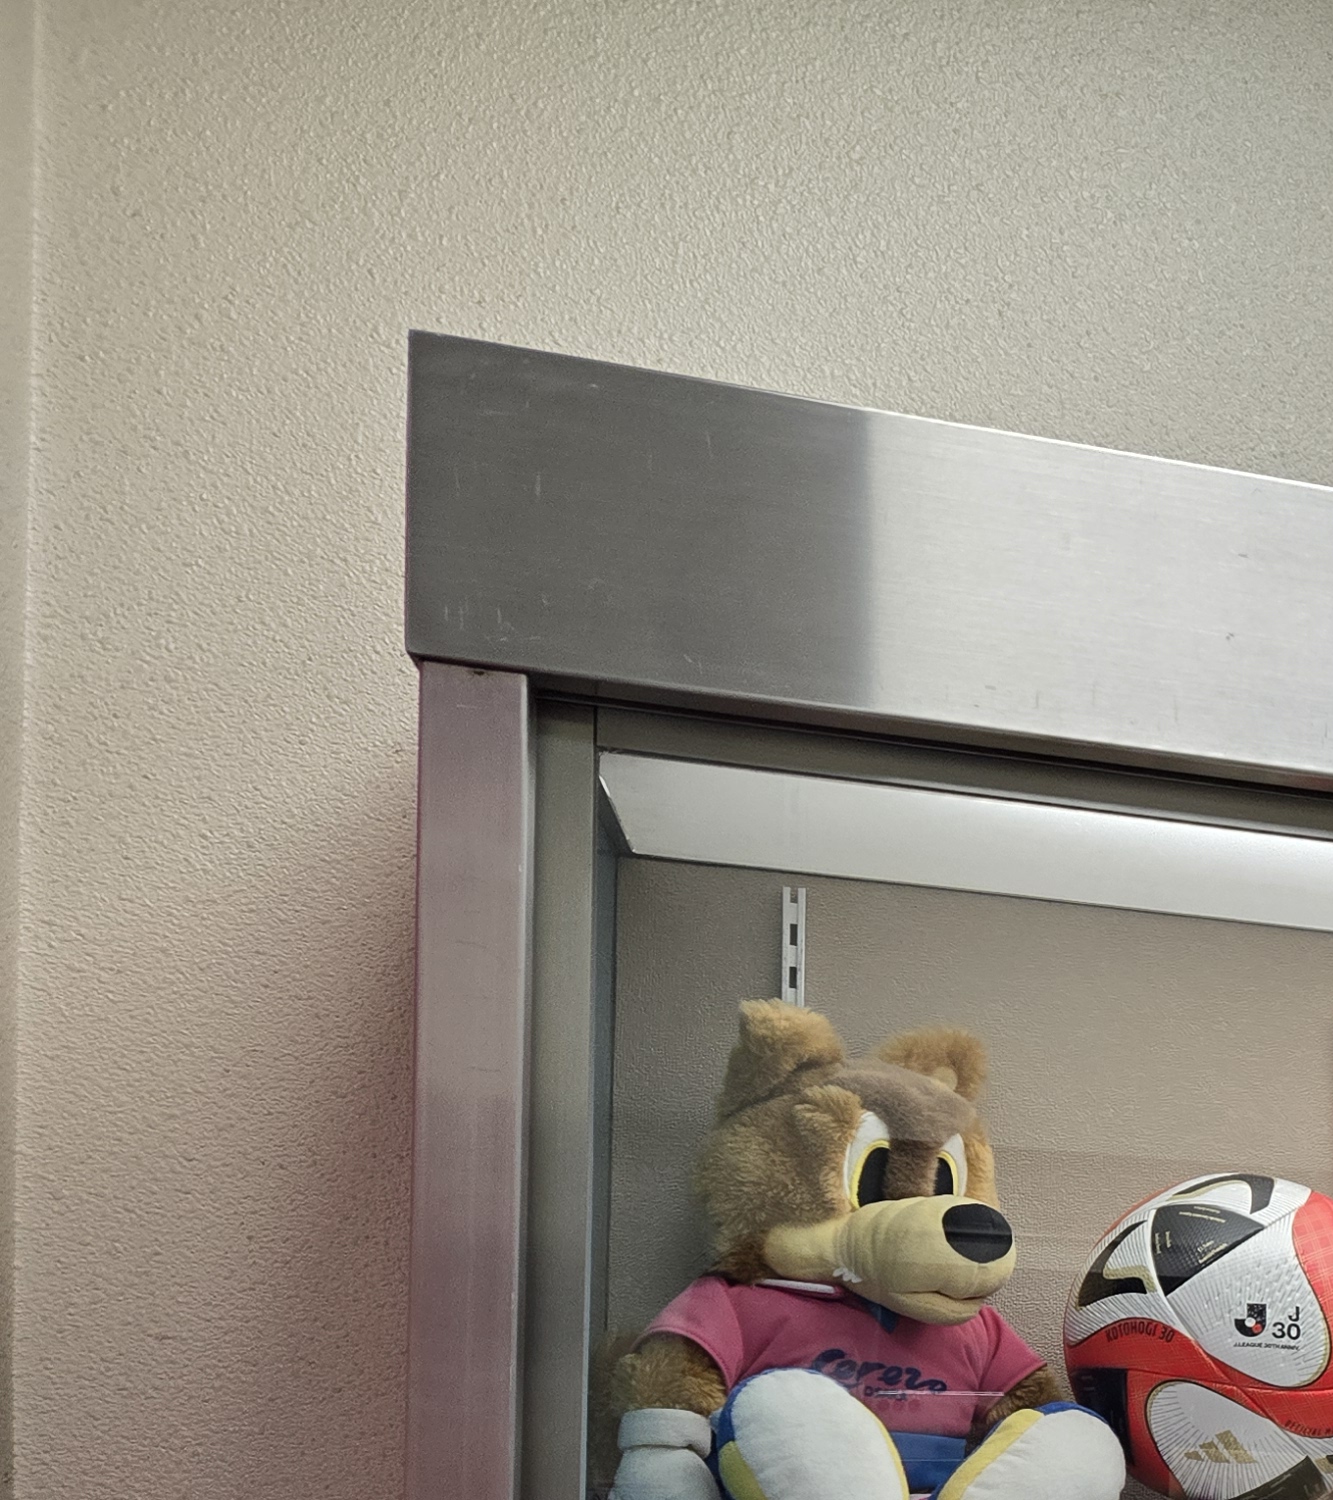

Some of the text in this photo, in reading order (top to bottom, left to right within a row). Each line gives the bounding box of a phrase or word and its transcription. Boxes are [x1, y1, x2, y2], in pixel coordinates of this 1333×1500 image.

[1288, 1306, 1300, 1322] J
[1105, 1319, 1175, 1344] KOTOHOGI 30
[1272, 1322, 1301, 1340] 30
